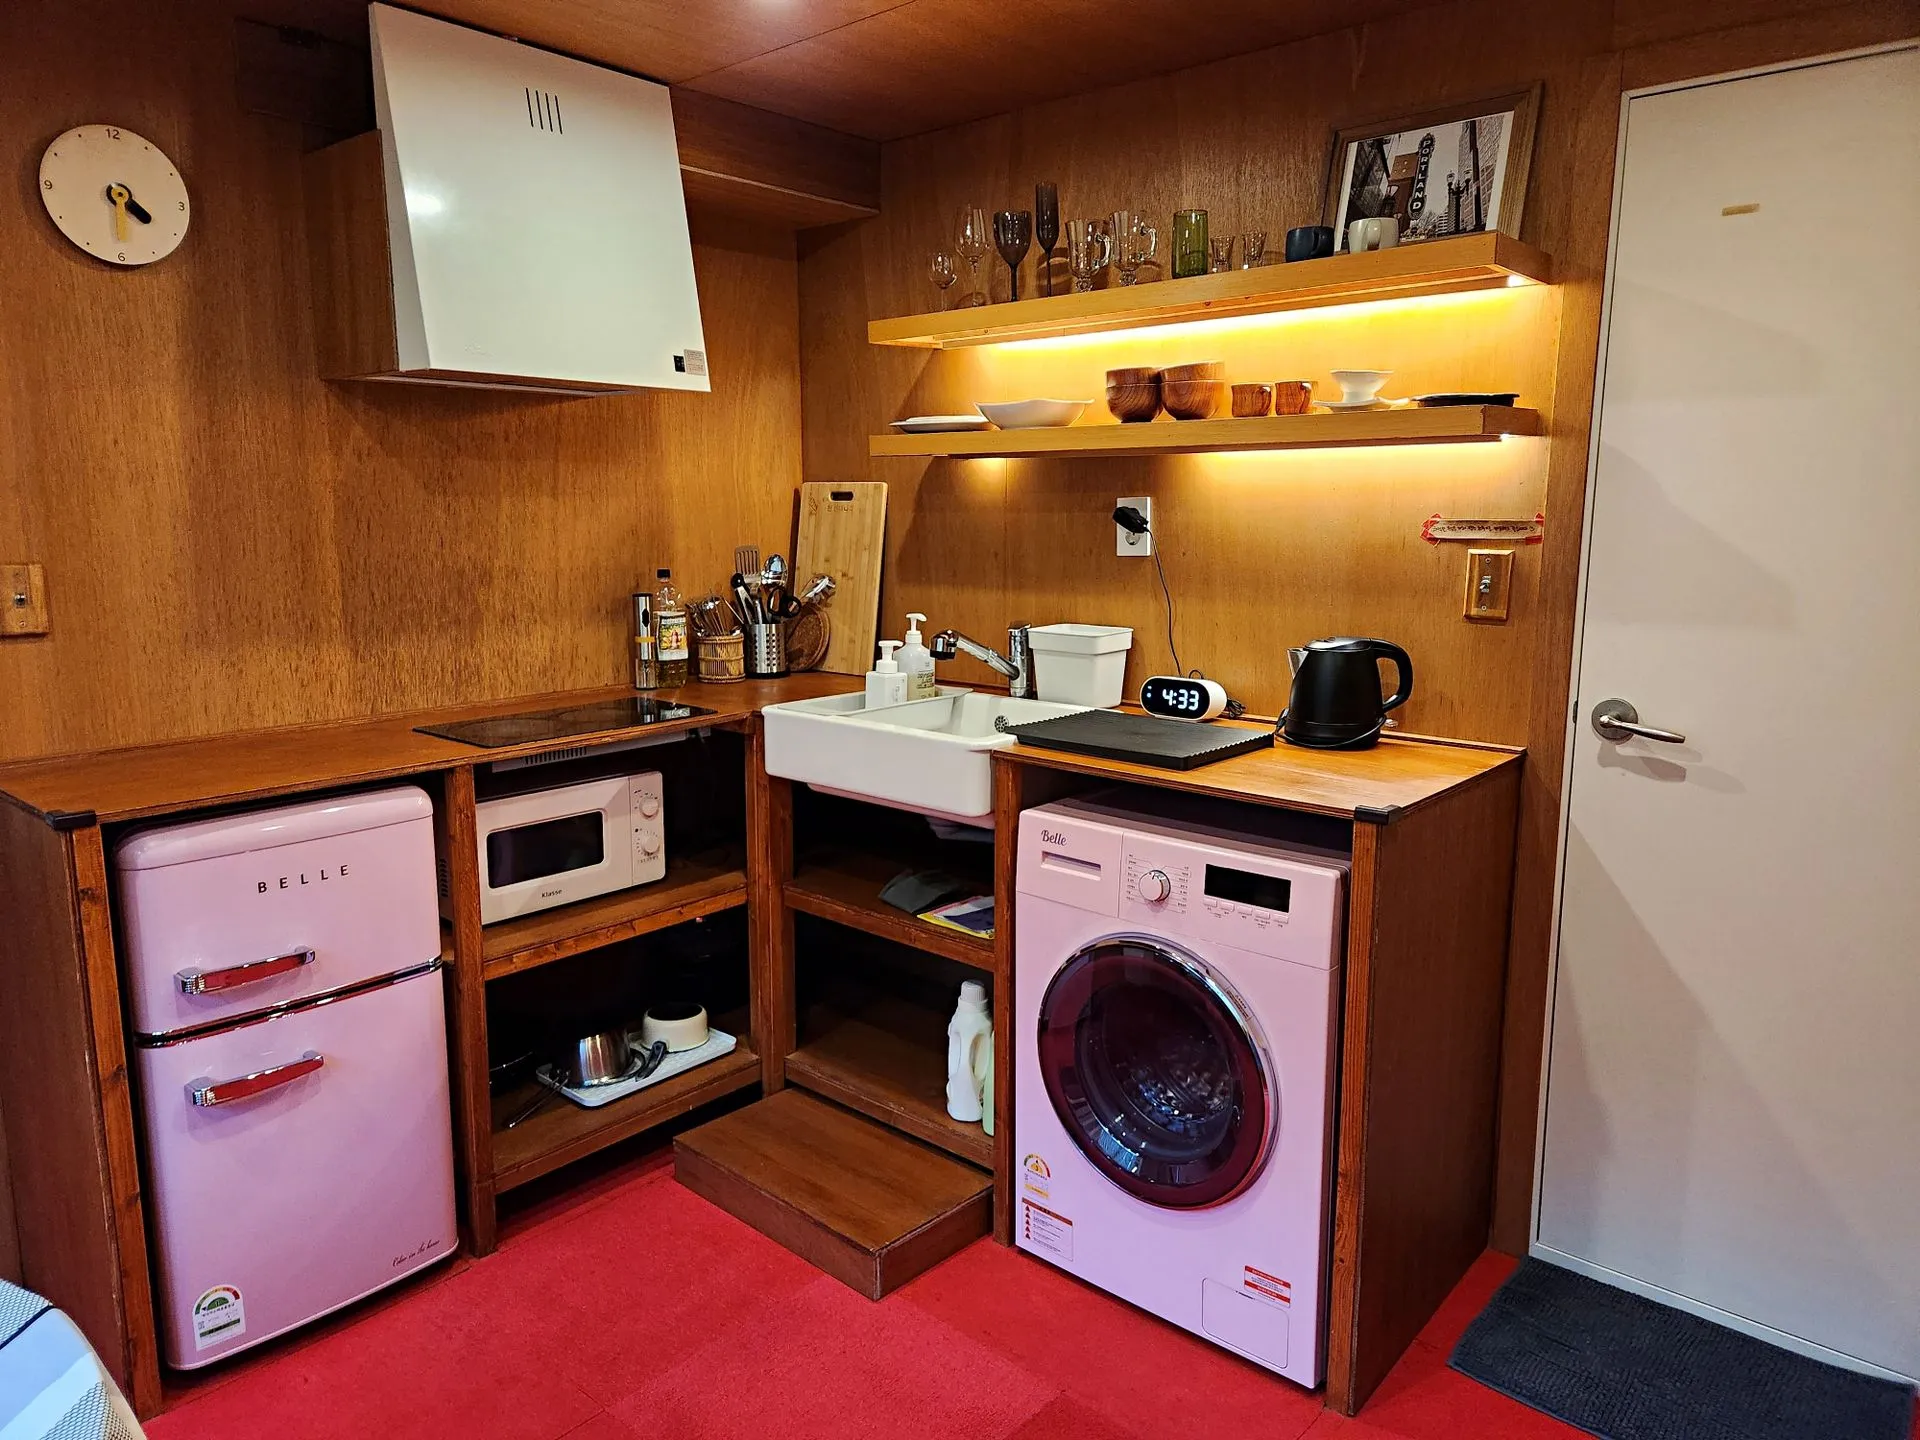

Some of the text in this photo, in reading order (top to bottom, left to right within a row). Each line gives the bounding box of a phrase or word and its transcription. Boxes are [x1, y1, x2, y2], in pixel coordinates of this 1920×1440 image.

[105, 128, 121, 140] 12
[1413, 140, 1431, 210] PORTLAND
[43, 179, 53, 190] 9
[177, 201, 186, 212] 3
[117, 252, 126, 262] 6
[1162, 688, 1200, 711] 4:33
[1041, 829, 1067, 846] Belle
[257, 864, 349, 894] BELLE
